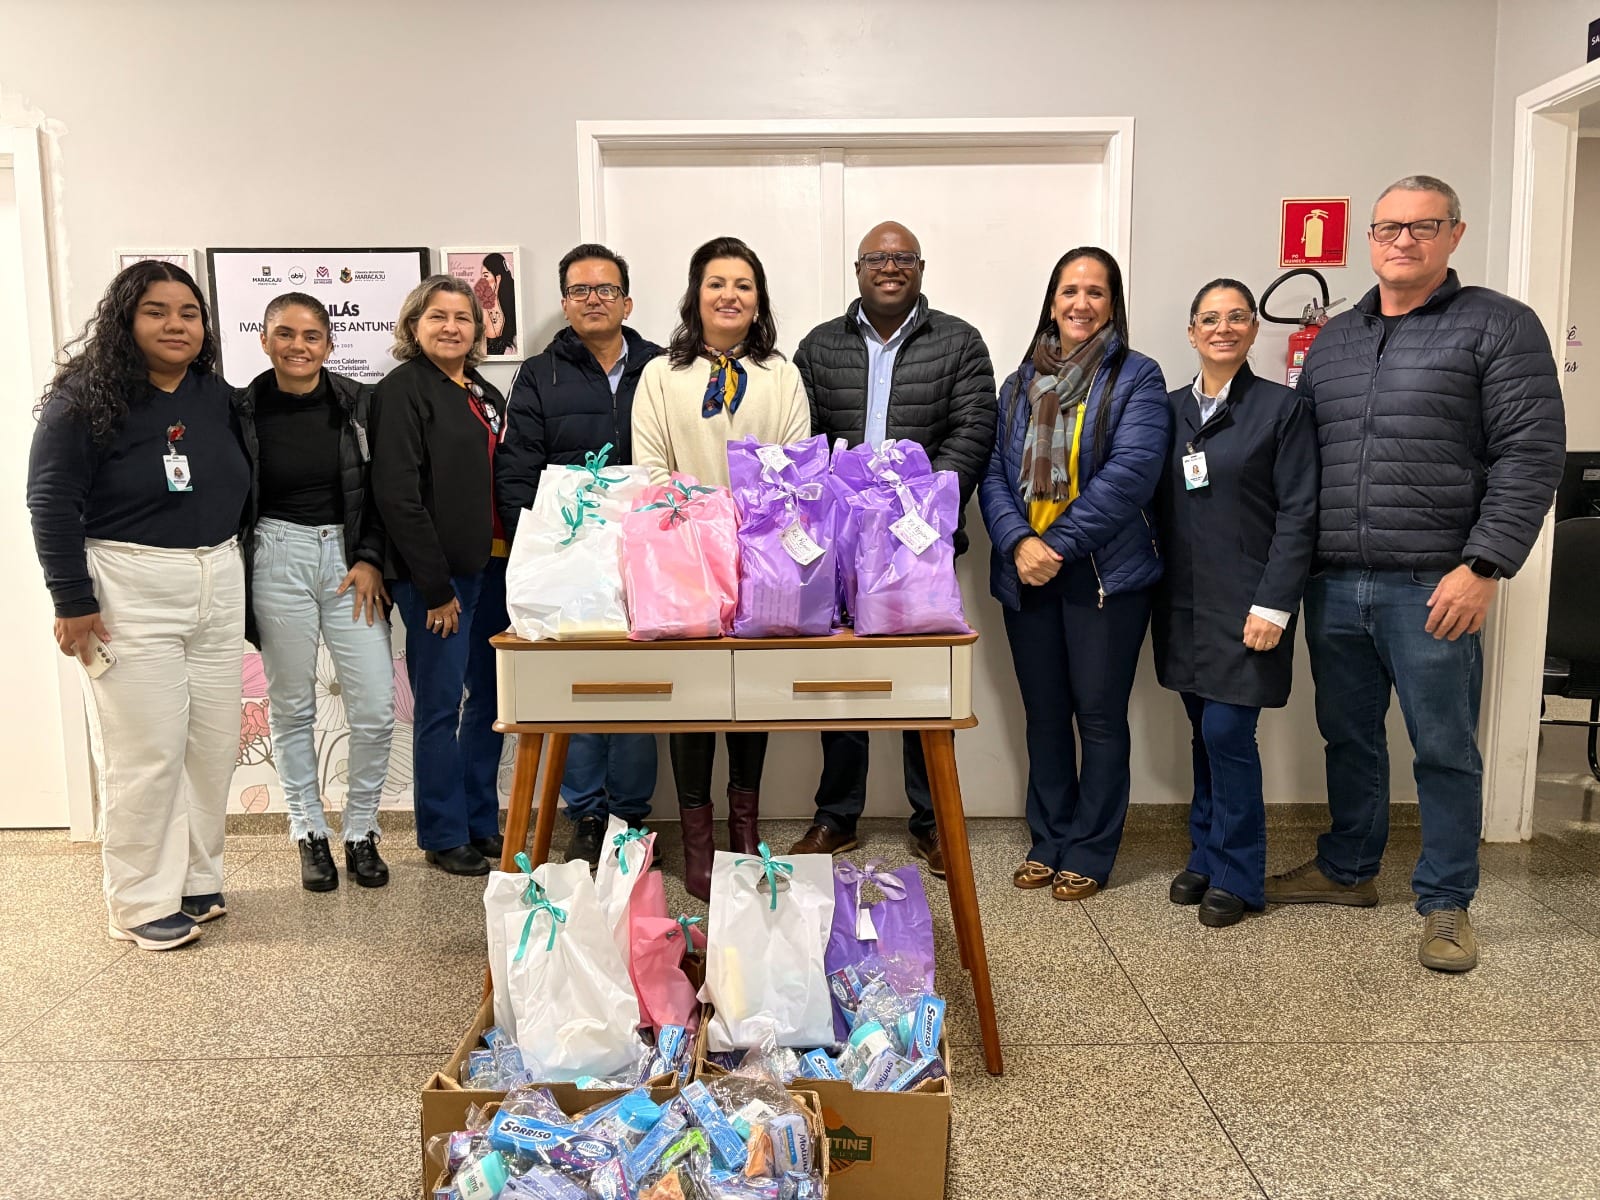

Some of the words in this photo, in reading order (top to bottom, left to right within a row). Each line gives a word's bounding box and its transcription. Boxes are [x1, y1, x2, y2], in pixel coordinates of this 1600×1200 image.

[1591, 34, 1600, 46] SA
[328, 300, 360, 316] ILÁS
[239, 322, 264, 332] IVAN
[329, 321, 346, 332] UES
[348, 321, 396, 332] ANTUNE
[924, 1005, 936, 1047] SORRISO
[500, 1120, 552, 1140] SORRISO
[828, 1138, 868, 1151] TINE
